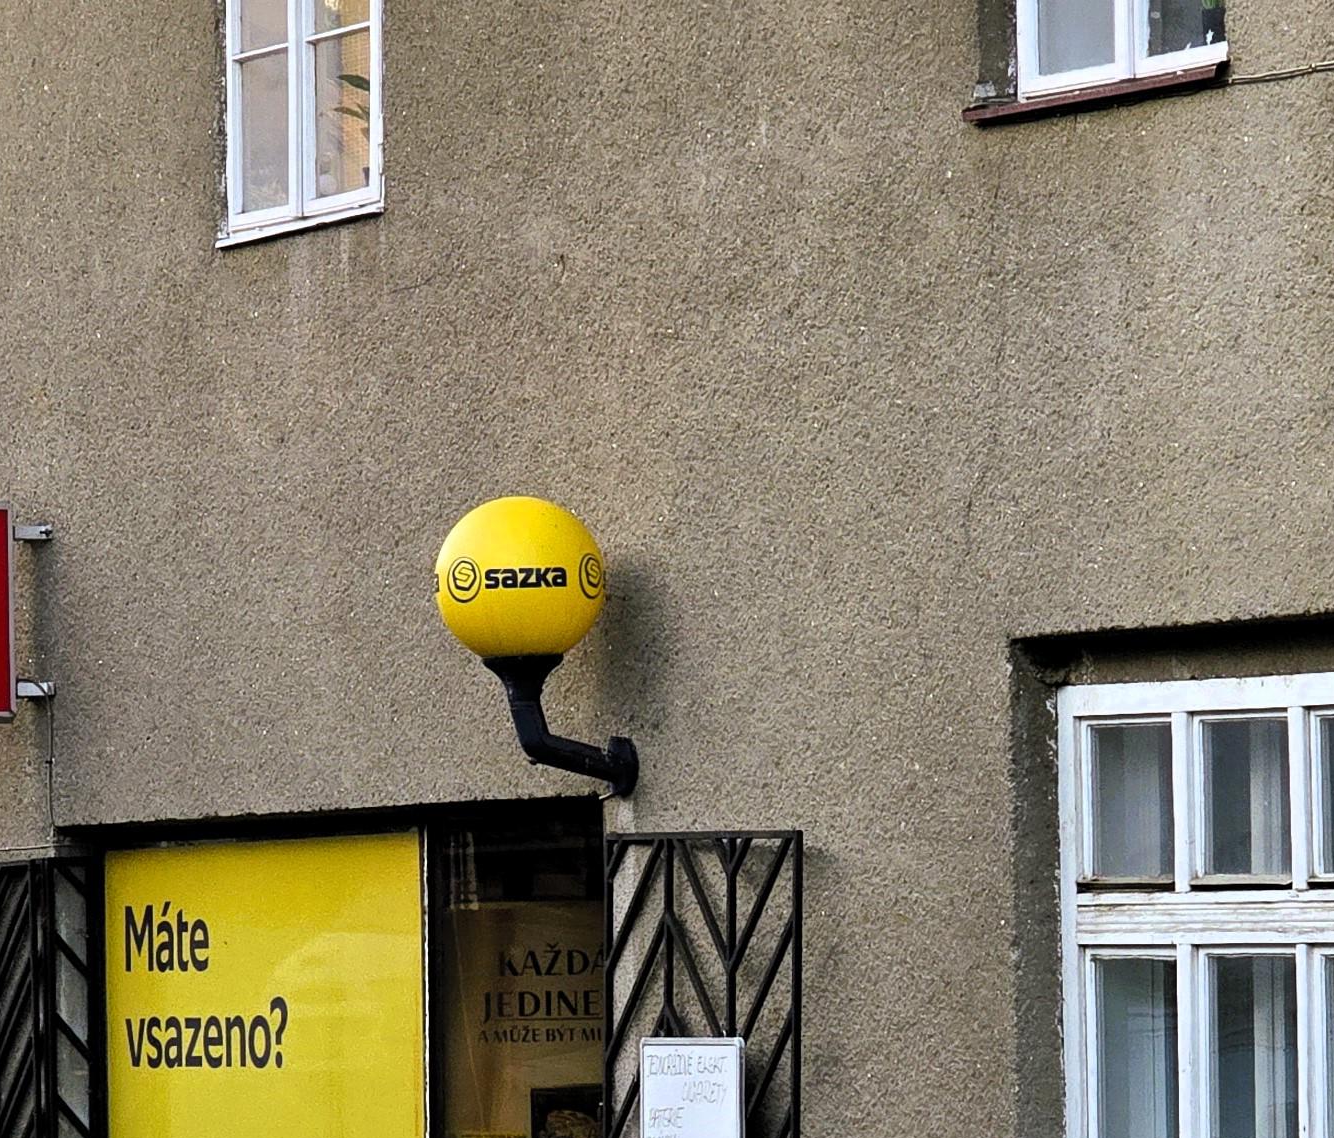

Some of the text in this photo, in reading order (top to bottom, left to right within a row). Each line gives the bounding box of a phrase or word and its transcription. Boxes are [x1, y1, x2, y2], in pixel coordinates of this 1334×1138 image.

[484, 566, 567, 590] sazka
[124, 901, 210, 973] Máte
[124, 996, 289, 1069] vsazeno?
[492, 1025, 540, 1043] MŮŽE
[546, 1025, 575, 1042] BÝT
